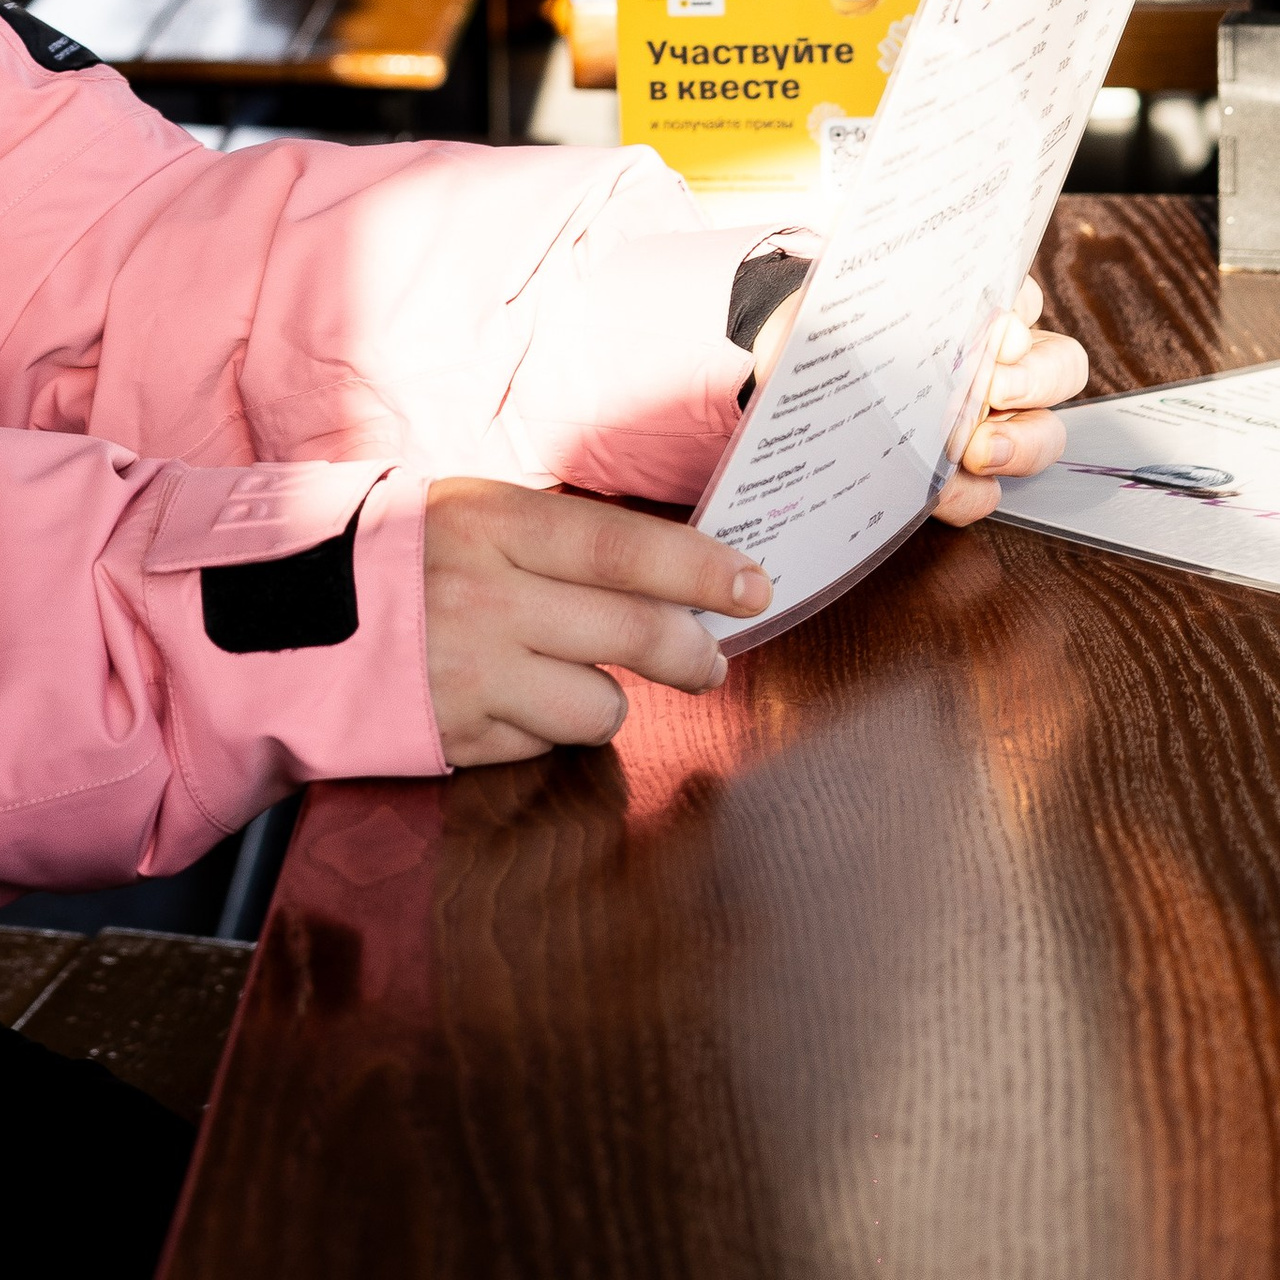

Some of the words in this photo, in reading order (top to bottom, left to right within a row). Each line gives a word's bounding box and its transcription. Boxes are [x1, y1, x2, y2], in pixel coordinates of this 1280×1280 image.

[646, 37, 854, 71] Участвуйте
[649, 80, 668, 101] в
[678, 77, 801, 101] квесте
[650, 120, 659, 130] и
[663, 116, 740, 133] получайте
[745, 118, 794, 133] призы
[737, 475, 775, 493] Куриные
[716, 519, 761, 537] Картофель
